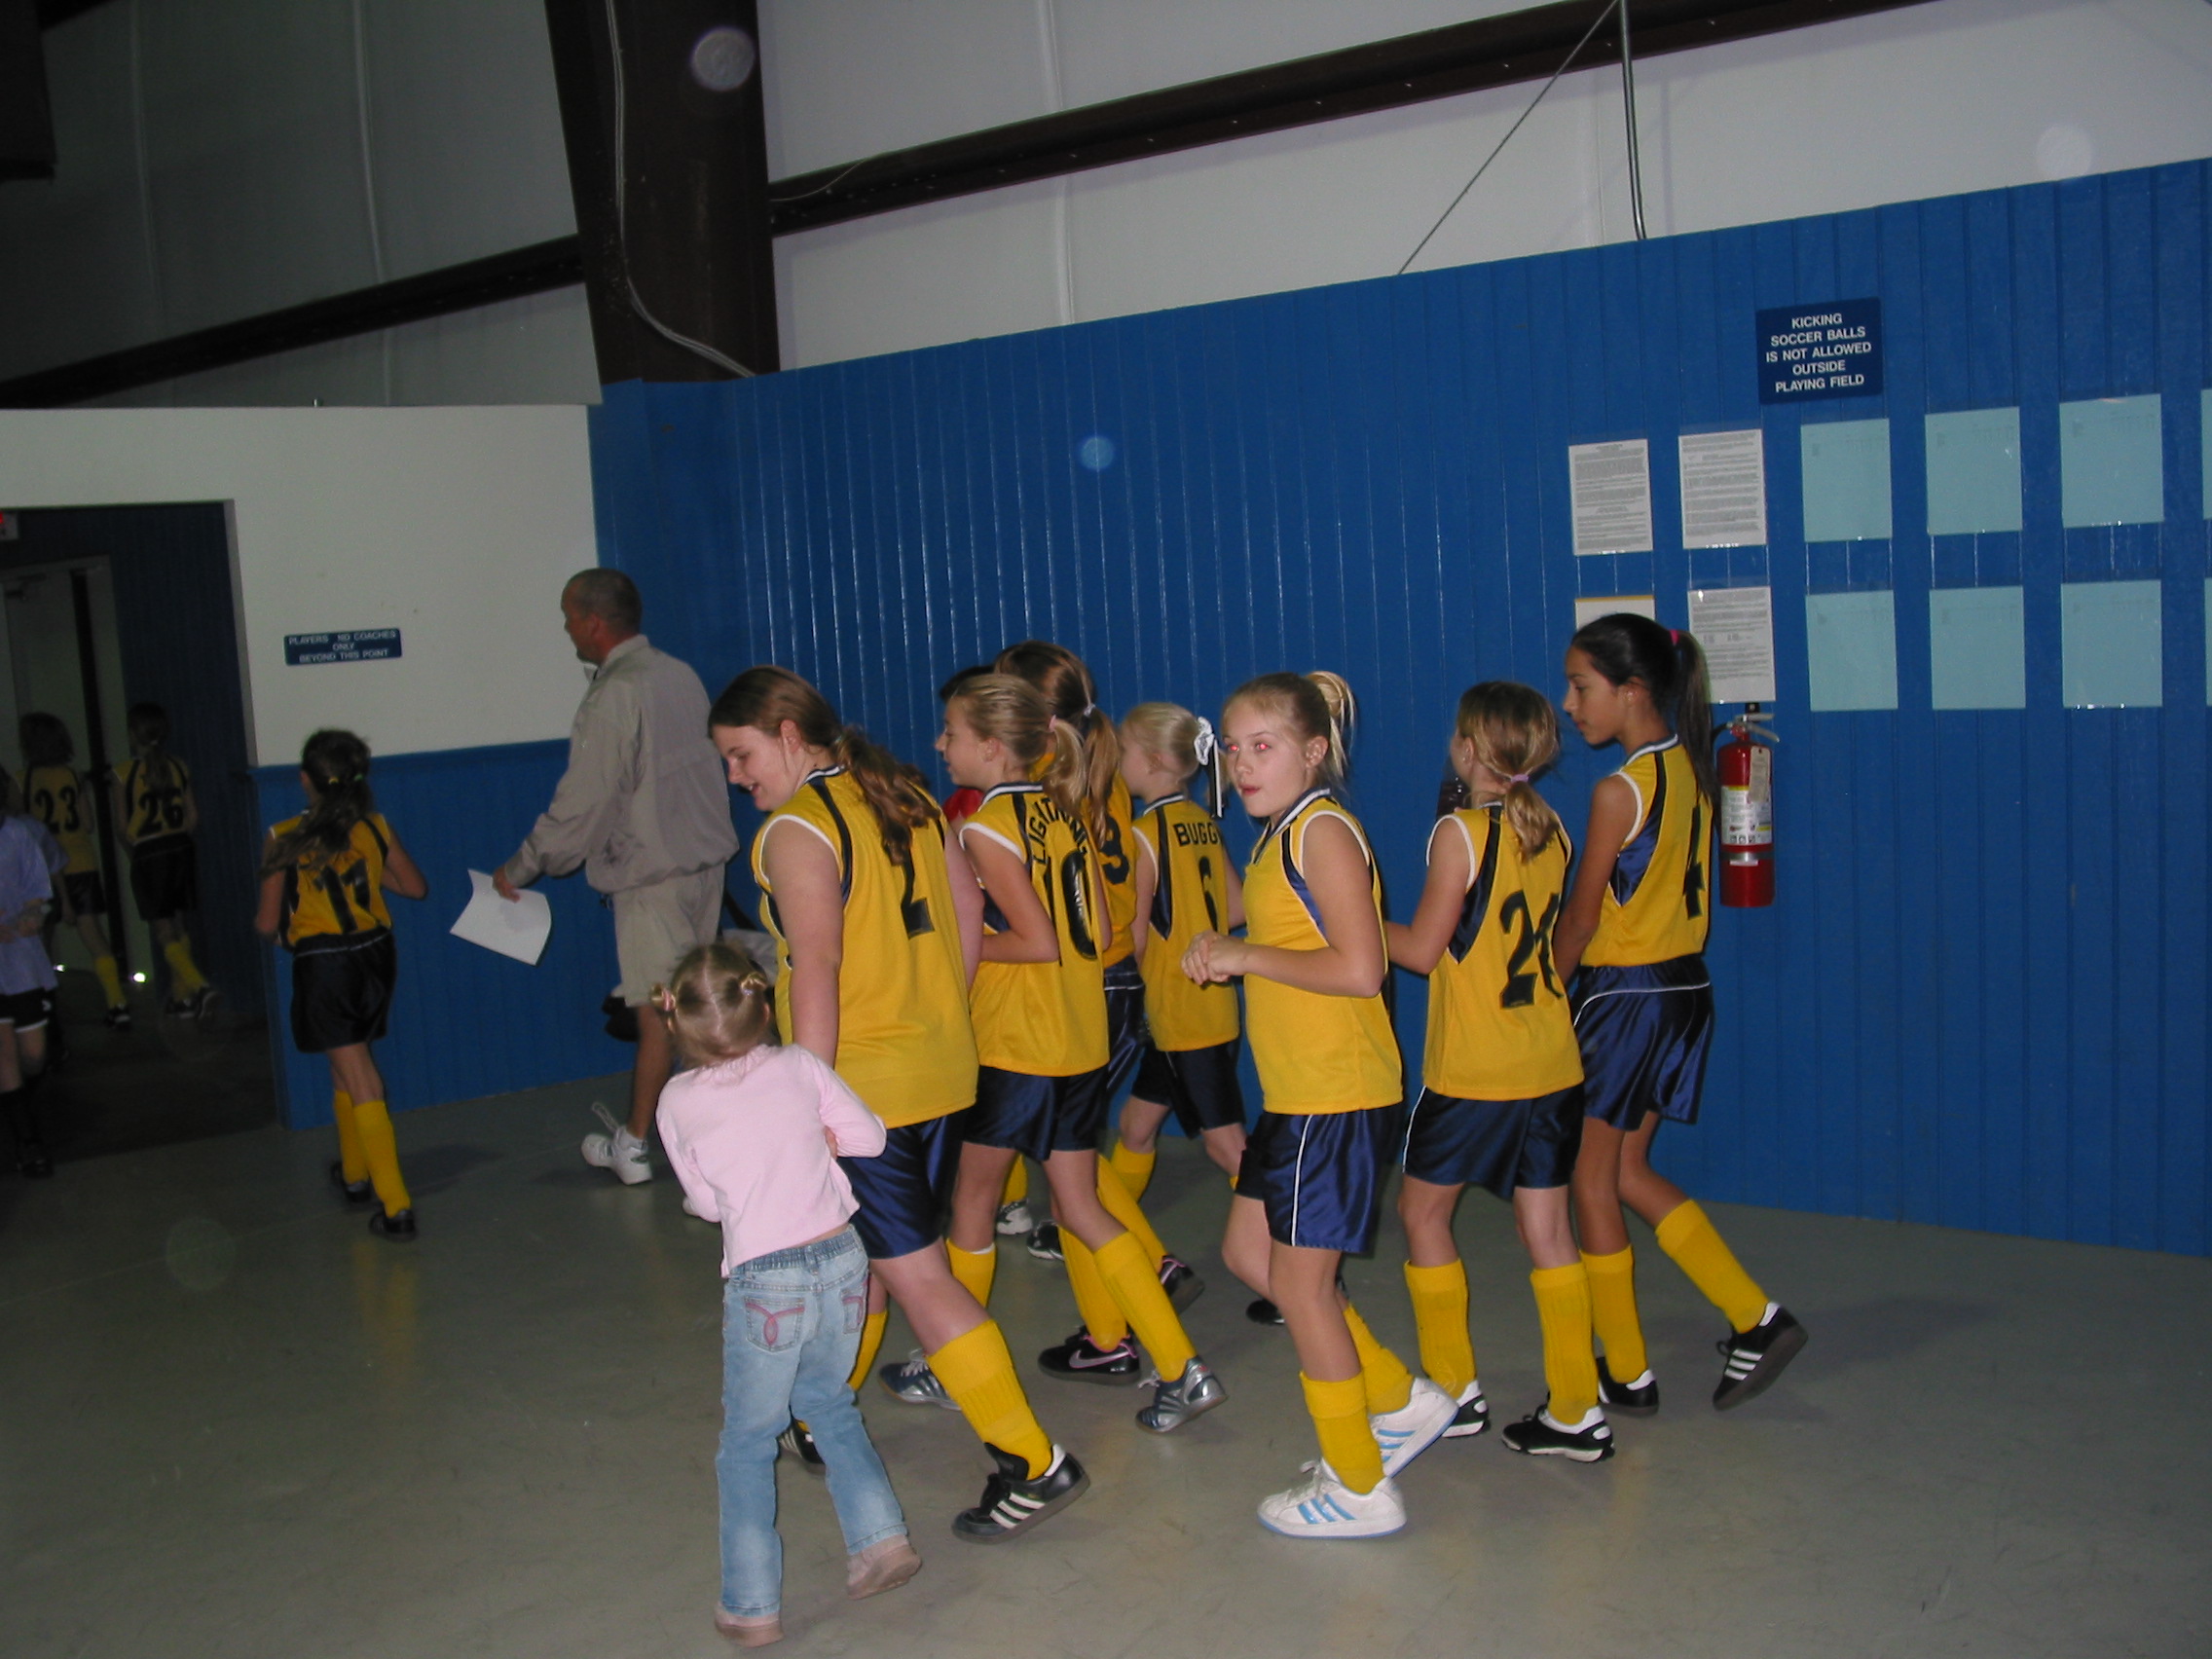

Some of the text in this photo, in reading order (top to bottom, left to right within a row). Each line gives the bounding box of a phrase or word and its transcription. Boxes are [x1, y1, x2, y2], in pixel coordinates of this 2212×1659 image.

[1791, 313, 1842, 329] KICKING
[1771, 326, 1865, 347] SOCCER BALLS
[1766, 342, 1871, 362] IS NOT ALLOWED
[1792, 360, 1846, 376] OUTSIDE
[1775, 374, 1864, 392] PLAYING FIELD
[288, 634, 329, 645] PLAYERS
[353, 630, 396, 641] COACHES
[299, 648, 388, 663] BEYOND THIS POINT
[332, 643, 354, 651] ONLY
[35, 786, 80, 834] 23
[138, 788, 184, 837] 26
[1044, 849, 1097, 967] 10
